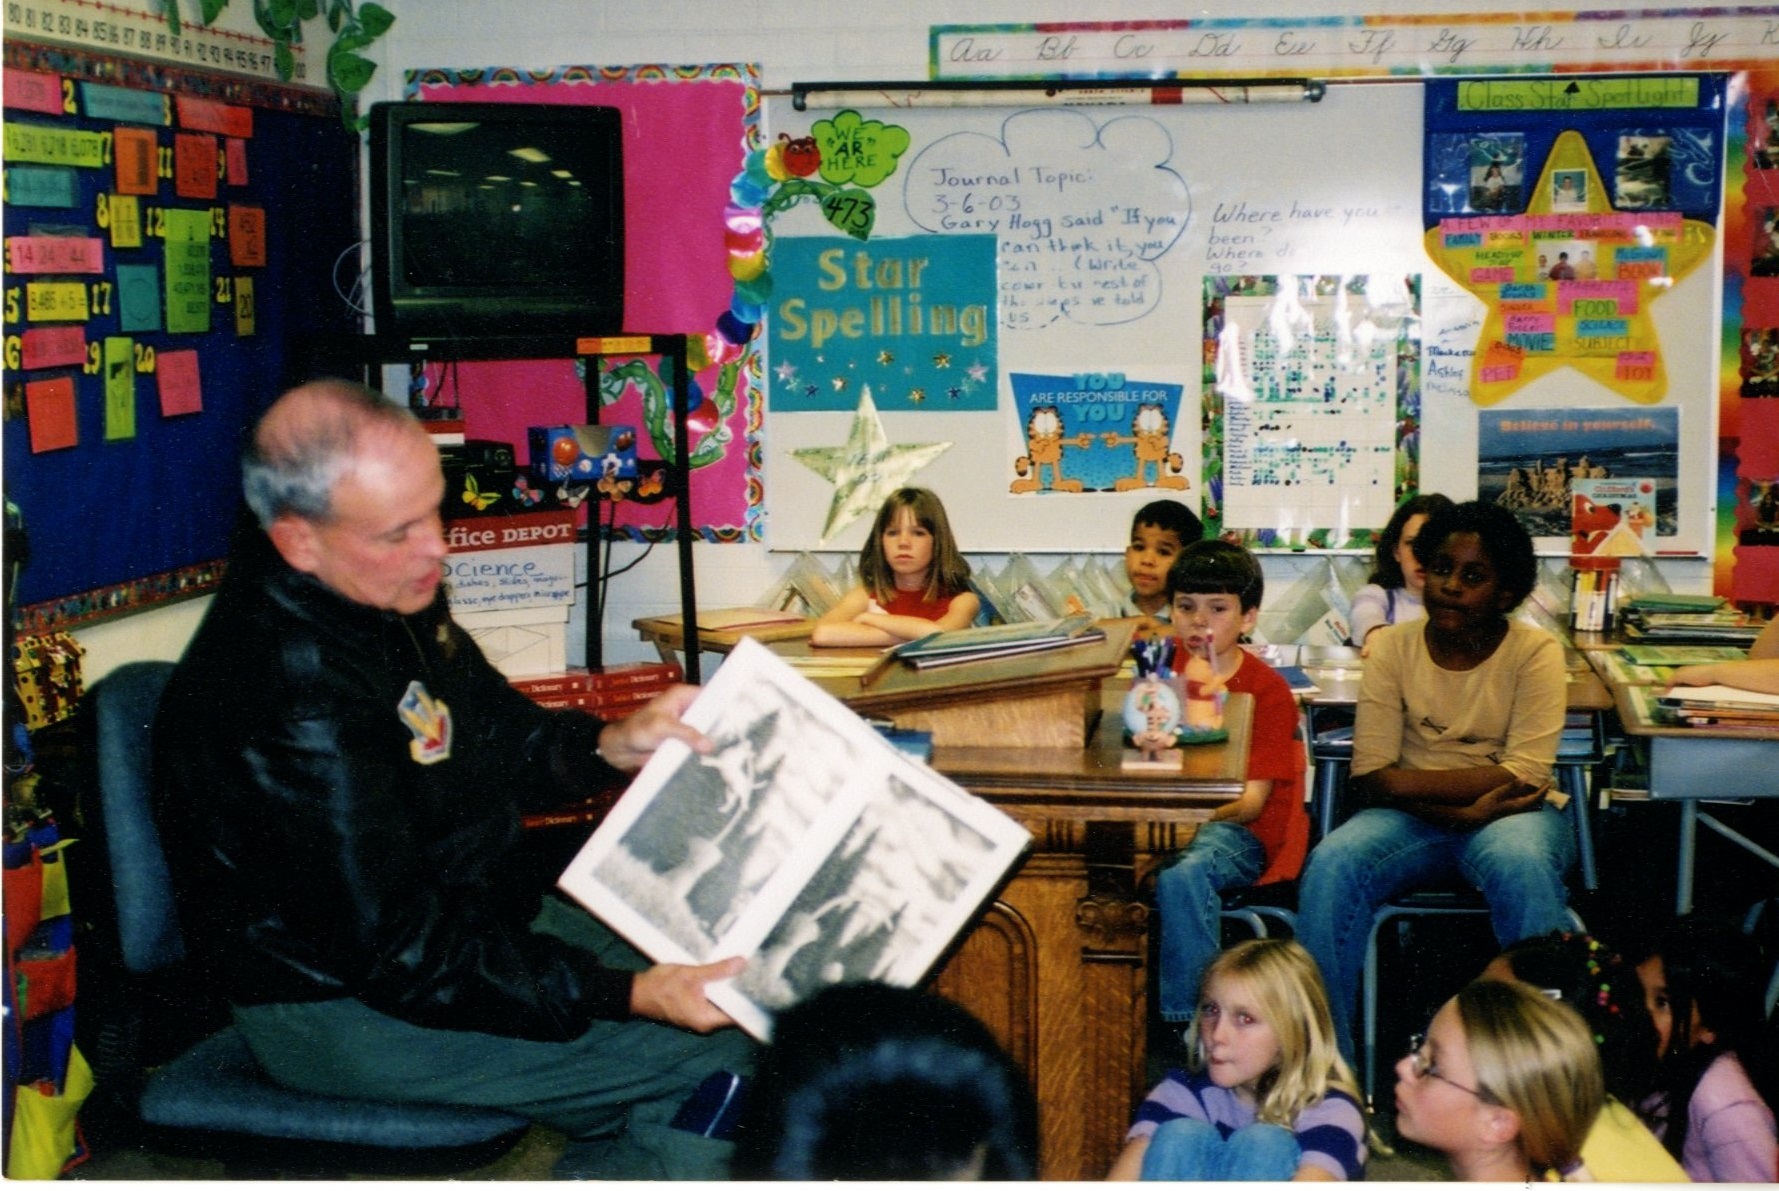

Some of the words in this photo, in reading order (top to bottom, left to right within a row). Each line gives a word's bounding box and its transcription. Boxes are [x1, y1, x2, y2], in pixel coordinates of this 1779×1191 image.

[951, 38, 1002, 62] Aa
[1036, 33, 1079, 60] Bb
[1114, 34, 1155, 59] Cc
[1188, 33, 1241, 57] Dd
[1274, 31, 1317, 56] Ee
[1349, 29, 1395, 62] Ff
[1427, 28, 1477, 62] Gg
[1510, 26, 1565, 50] Hh
[1599, 26, 1654, 49] Ii
[1680, 21, 1729, 58] Jj
[62, 79, 77, 114] 2
[1467, 80, 1524, 109] Class
[1530, 79, 1574, 108] Star
[835, 126, 867, 141] WE
[100, 131, 112, 164] 7
[828, 154, 877, 171] HERE
[930, 168, 1019, 186] Journal
[1030, 167, 1094, 191] Topic:
[96, 192, 109, 228] 8
[827, 196, 873, 229] 473
[931, 193, 1021, 213] 3-6-03
[1213, 200, 1283, 223] Where
[1290, 199, 1336, 219] have
[1343, 206, 1379, 226] you
[147, 207, 166, 237] 12
[941, 214, 1000, 231] Gary
[1009, 213, 1051, 239] Hogg
[1144, 215, 1176, 233] you
[1458, 217, 1490, 230] FEW
[1136, 240, 1165, 256] you
[1206, 247, 1264, 260] Where
[818, 248, 929, 292] Star
[92, 282, 112, 315] 17
[216, 277, 232, 303] 21
[1115, 291, 1145, 305] told
[1574, 299, 1617, 318] FOOD
[779, 293, 989, 349] Spelling
[1574, 338, 1631, 350] SUBJECT
[134, 343, 155, 373] 20
[1427, 359, 1463, 380] Ashley
[1480, 364, 1516, 384] PET
[1621, 365, 1653, 381] TOY
[1072, 373, 1126, 390] YOU
[1030, 392, 1055, 404] ARE
[1057, 391, 1140, 403] RESPONSIBLE
[1142, 390, 1168, 401] FOR
[1072, 404, 1126, 422] YOU
[448, 527, 496, 547] fice
[502, 523, 572, 543] DEPOT
[531, 684, 563, 693] Dictionary
[631, 674, 659, 684] Dictionary
[545, 816, 577, 825] Dictionary
